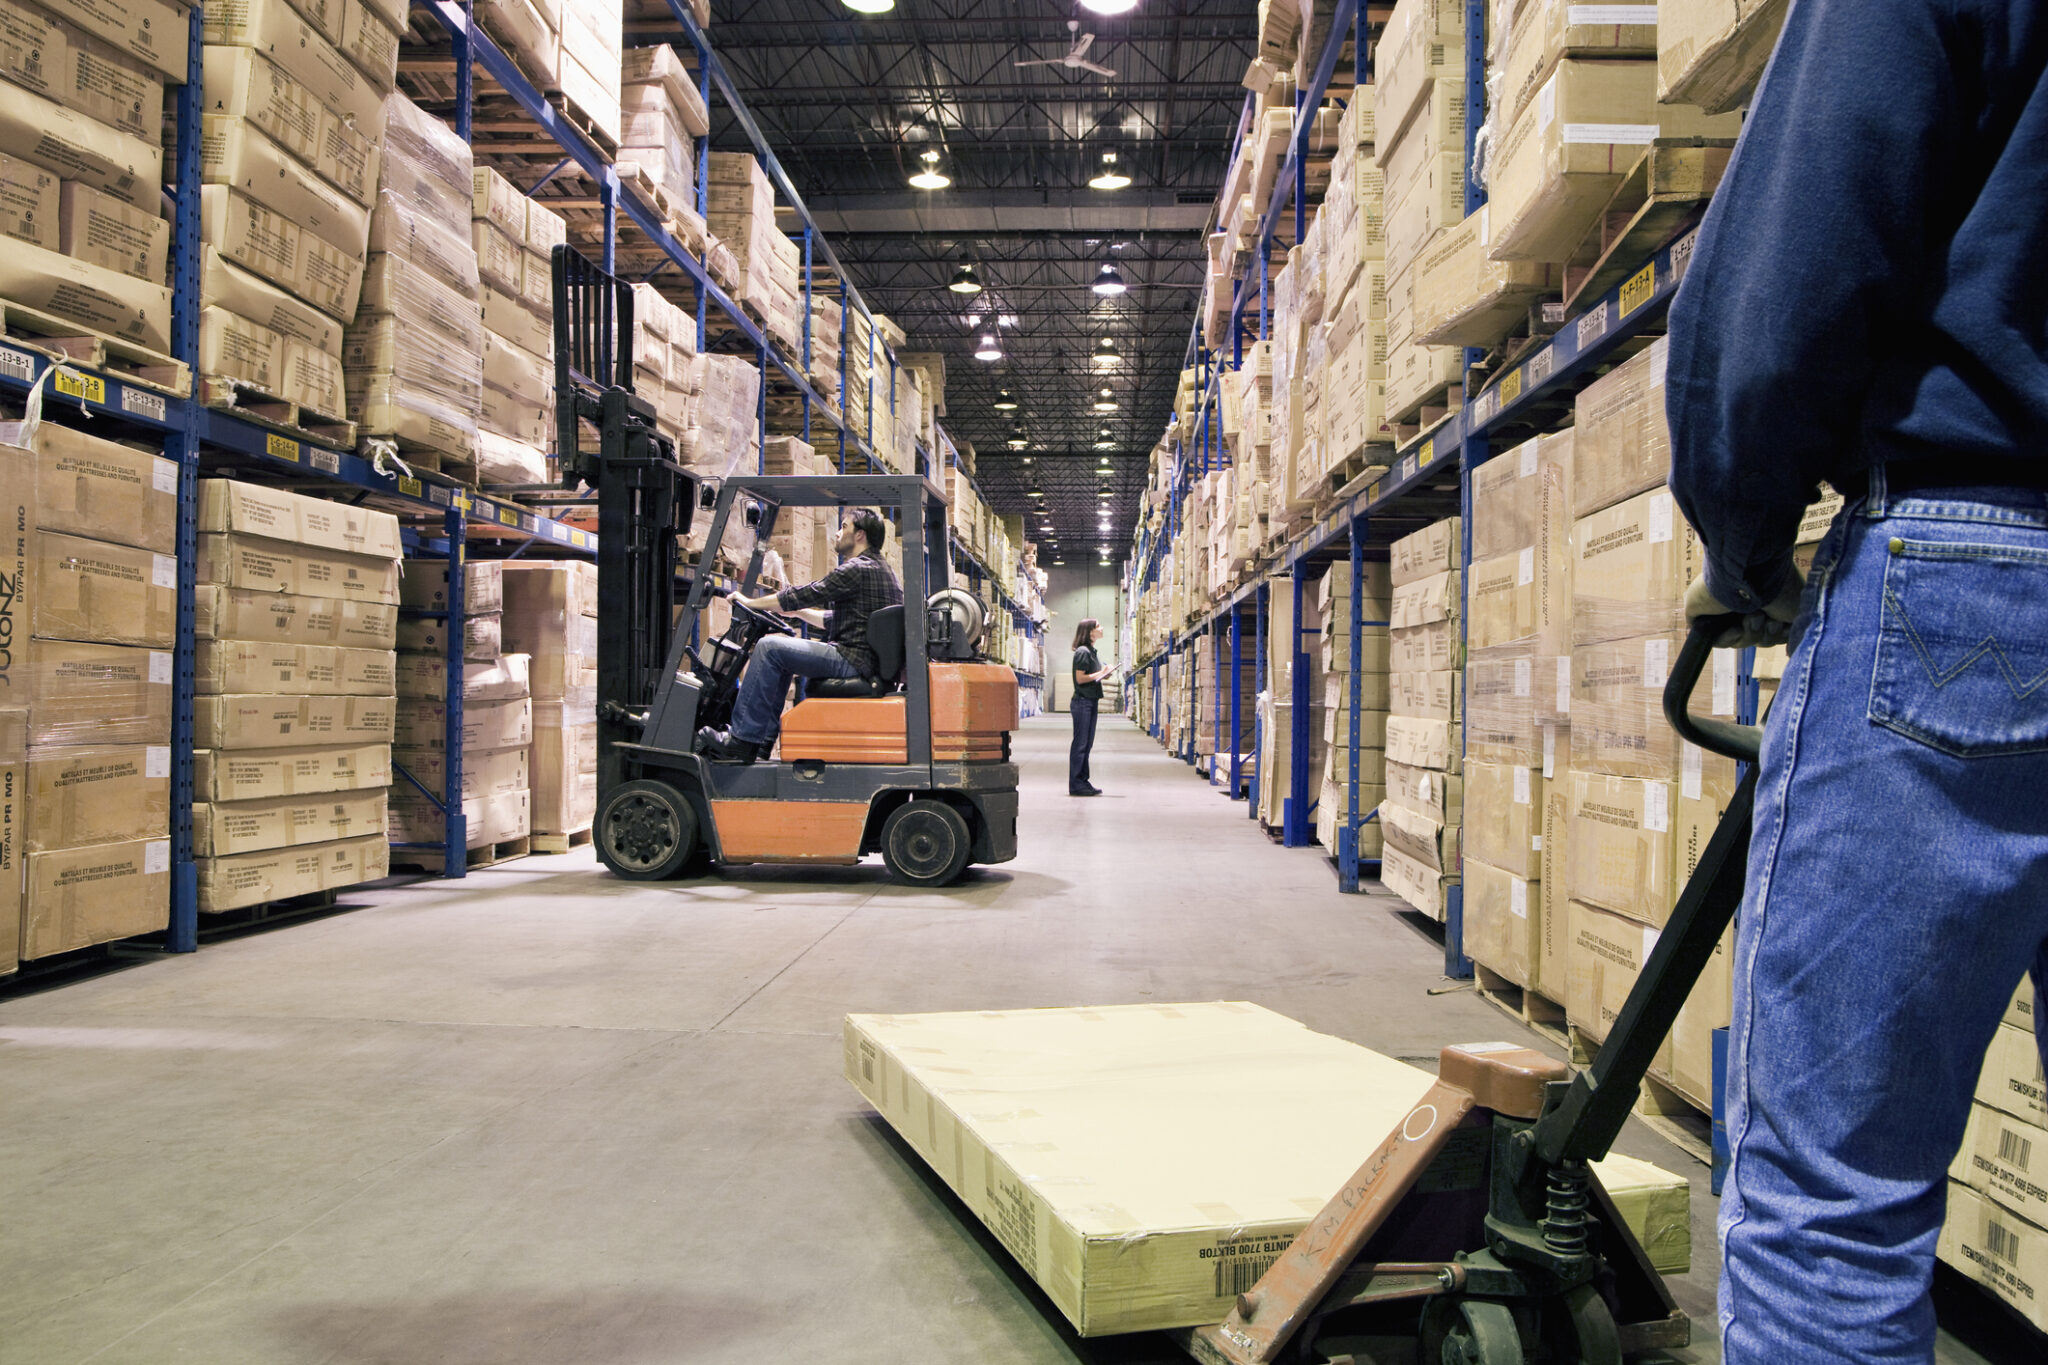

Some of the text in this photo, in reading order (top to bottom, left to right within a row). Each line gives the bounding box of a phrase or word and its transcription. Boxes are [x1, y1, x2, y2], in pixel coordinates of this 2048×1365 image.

[1622, 270, 1650, 301] 1-F-13-A
[60, 374, 100, 390] 1-G-3-B
[126, 391, 162, 410] 1-G-13-B-2
[16, 505, 25, 603] BY/PAR PR MO
[3, 771, 13, 870] BY/PAR PR MO
[1199, 1246, 1236, 1258] BLKTOB
[1239, 1244, 1260, 1254] 7700
